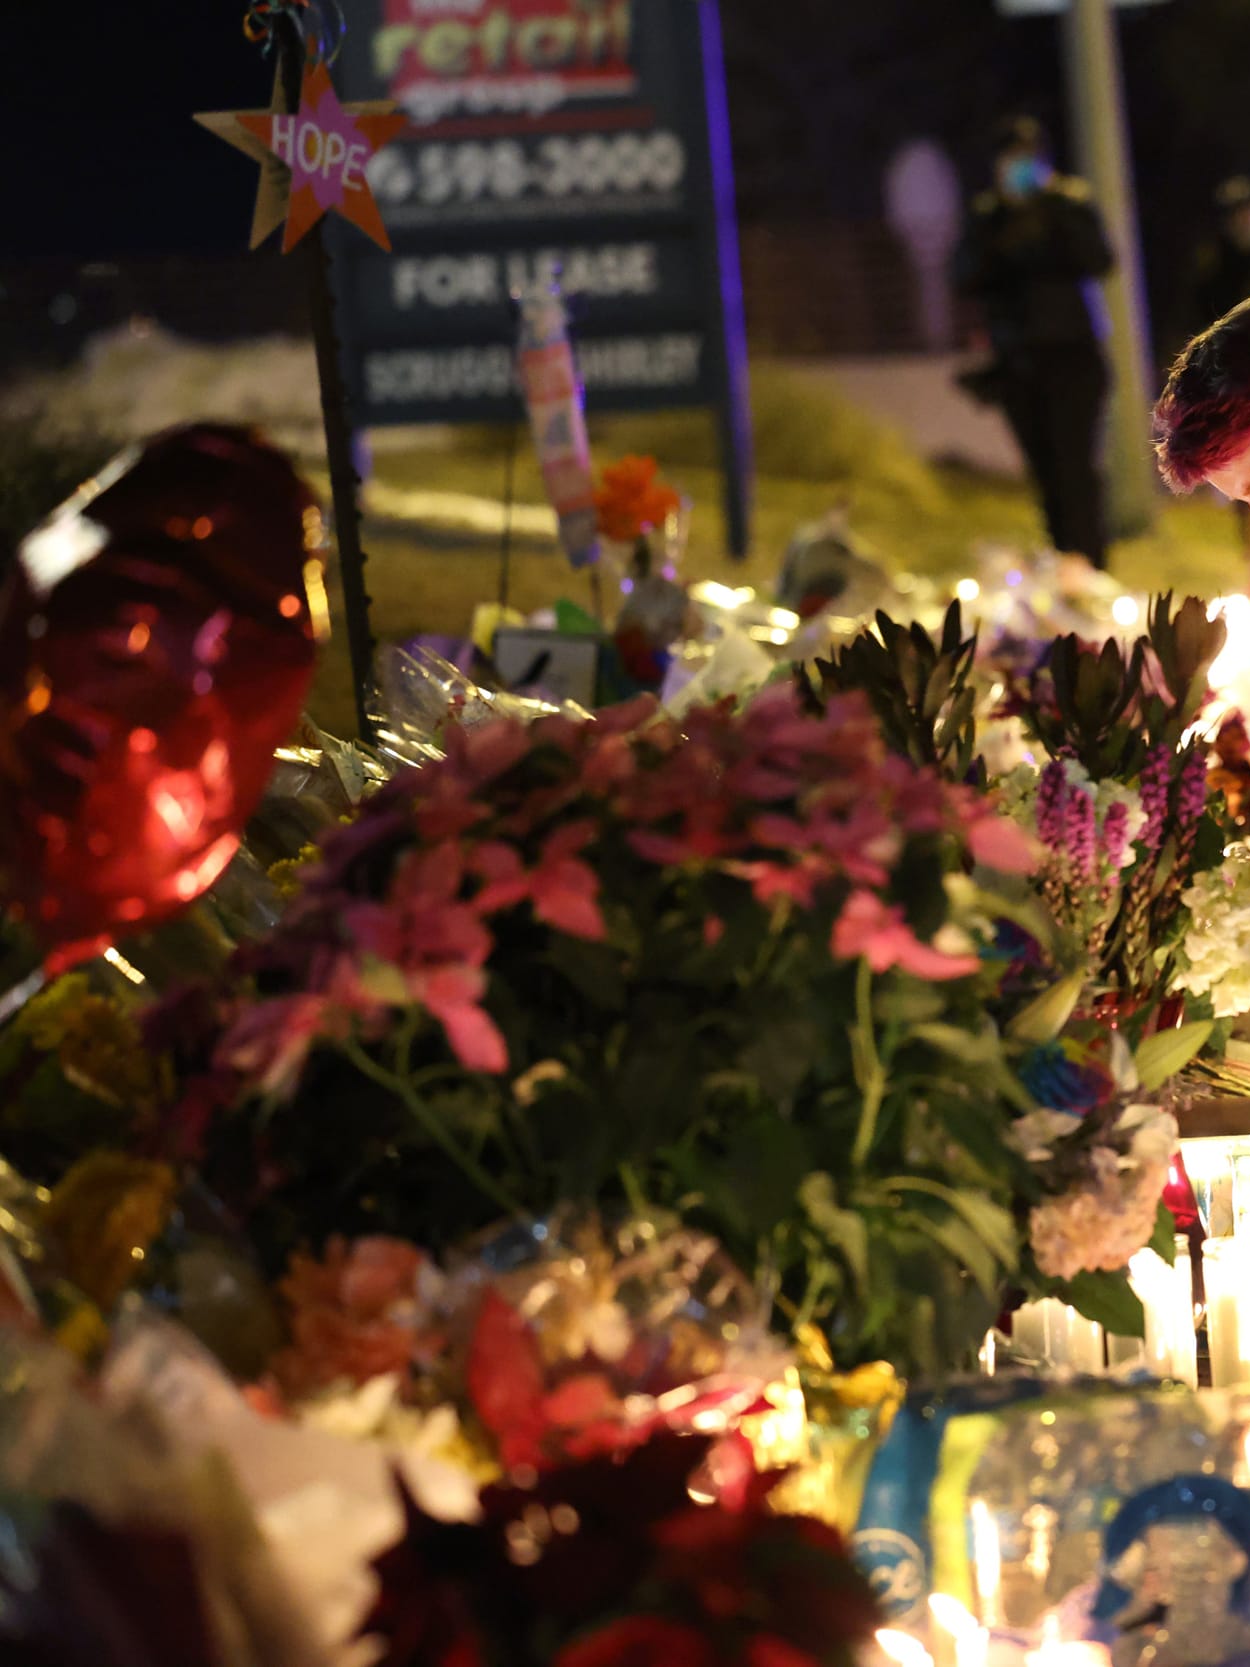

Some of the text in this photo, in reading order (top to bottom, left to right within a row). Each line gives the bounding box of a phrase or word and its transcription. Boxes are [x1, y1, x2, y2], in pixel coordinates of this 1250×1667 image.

[371, 0, 634, 79] retail
[407, 78, 564, 124] group
[271, 113, 367, 191] HOPE
[394, 243, 655, 308] FOR LEASE
